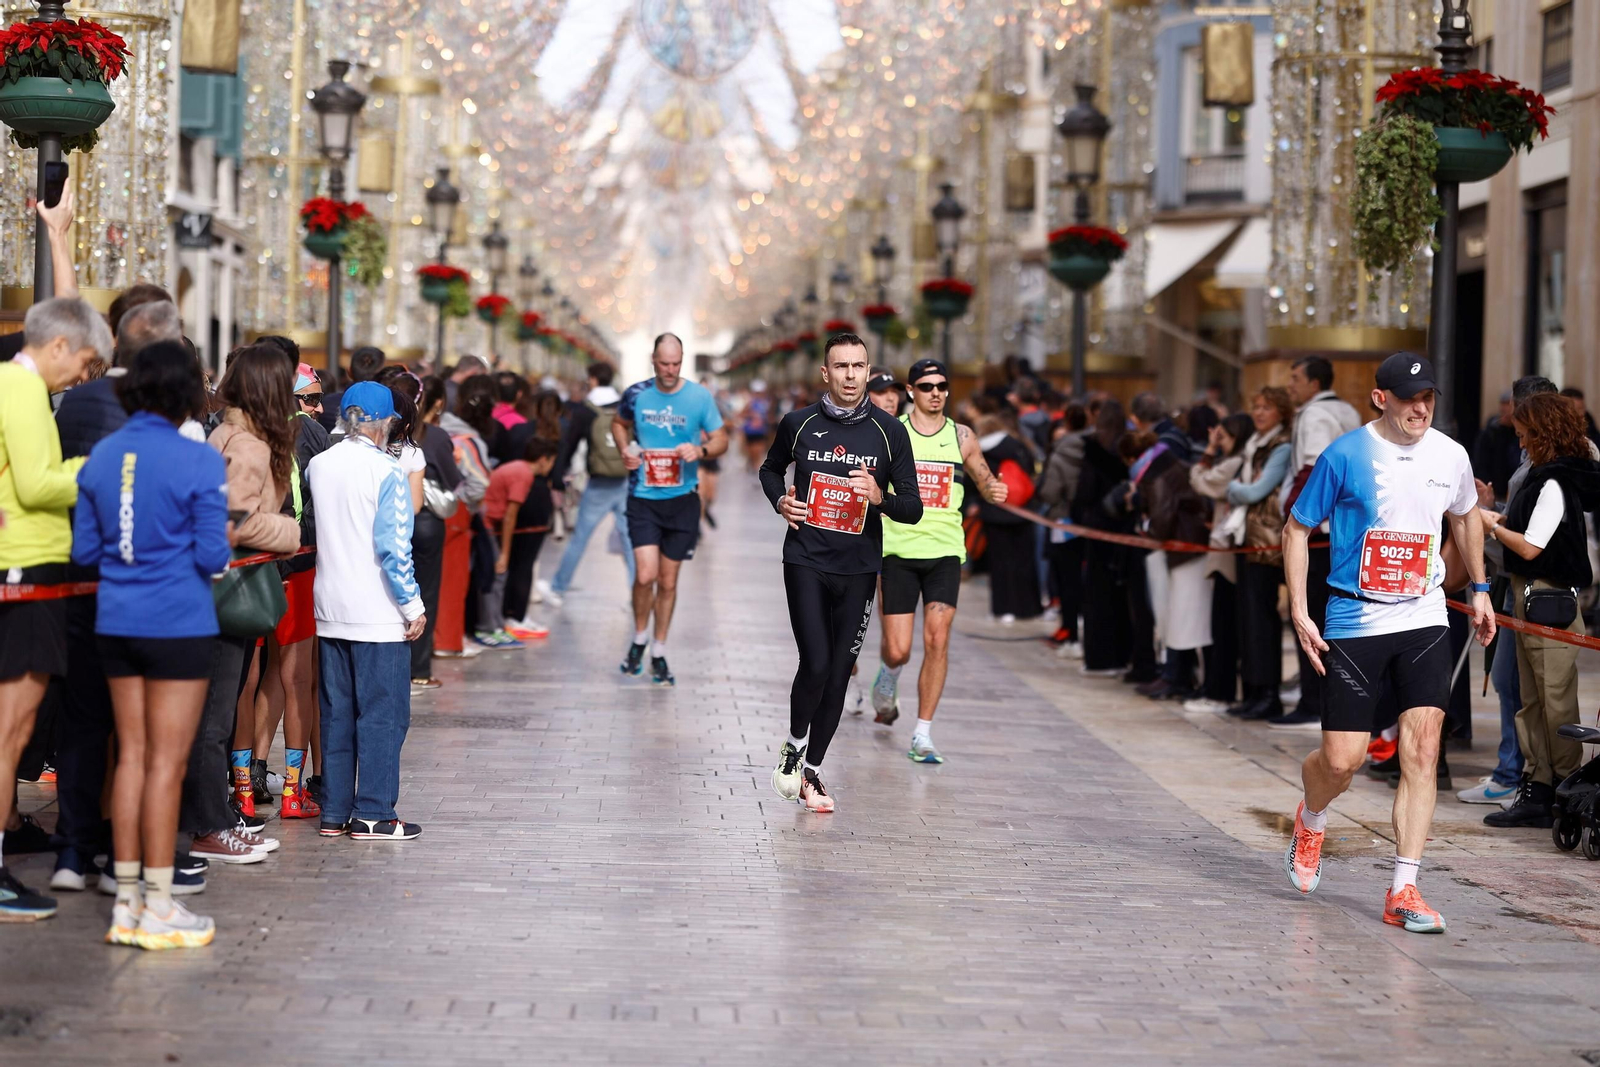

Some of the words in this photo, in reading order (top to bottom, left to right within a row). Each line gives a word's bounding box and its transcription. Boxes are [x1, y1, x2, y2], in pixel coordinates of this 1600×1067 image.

[807, 450, 877, 467] ELEMENTI
[822, 489, 851, 502] 6502
[1383, 532, 1425, 543] GENERALI
[1380, 545, 1413, 560] 9025
[850, 600, 872, 654] NIKE
